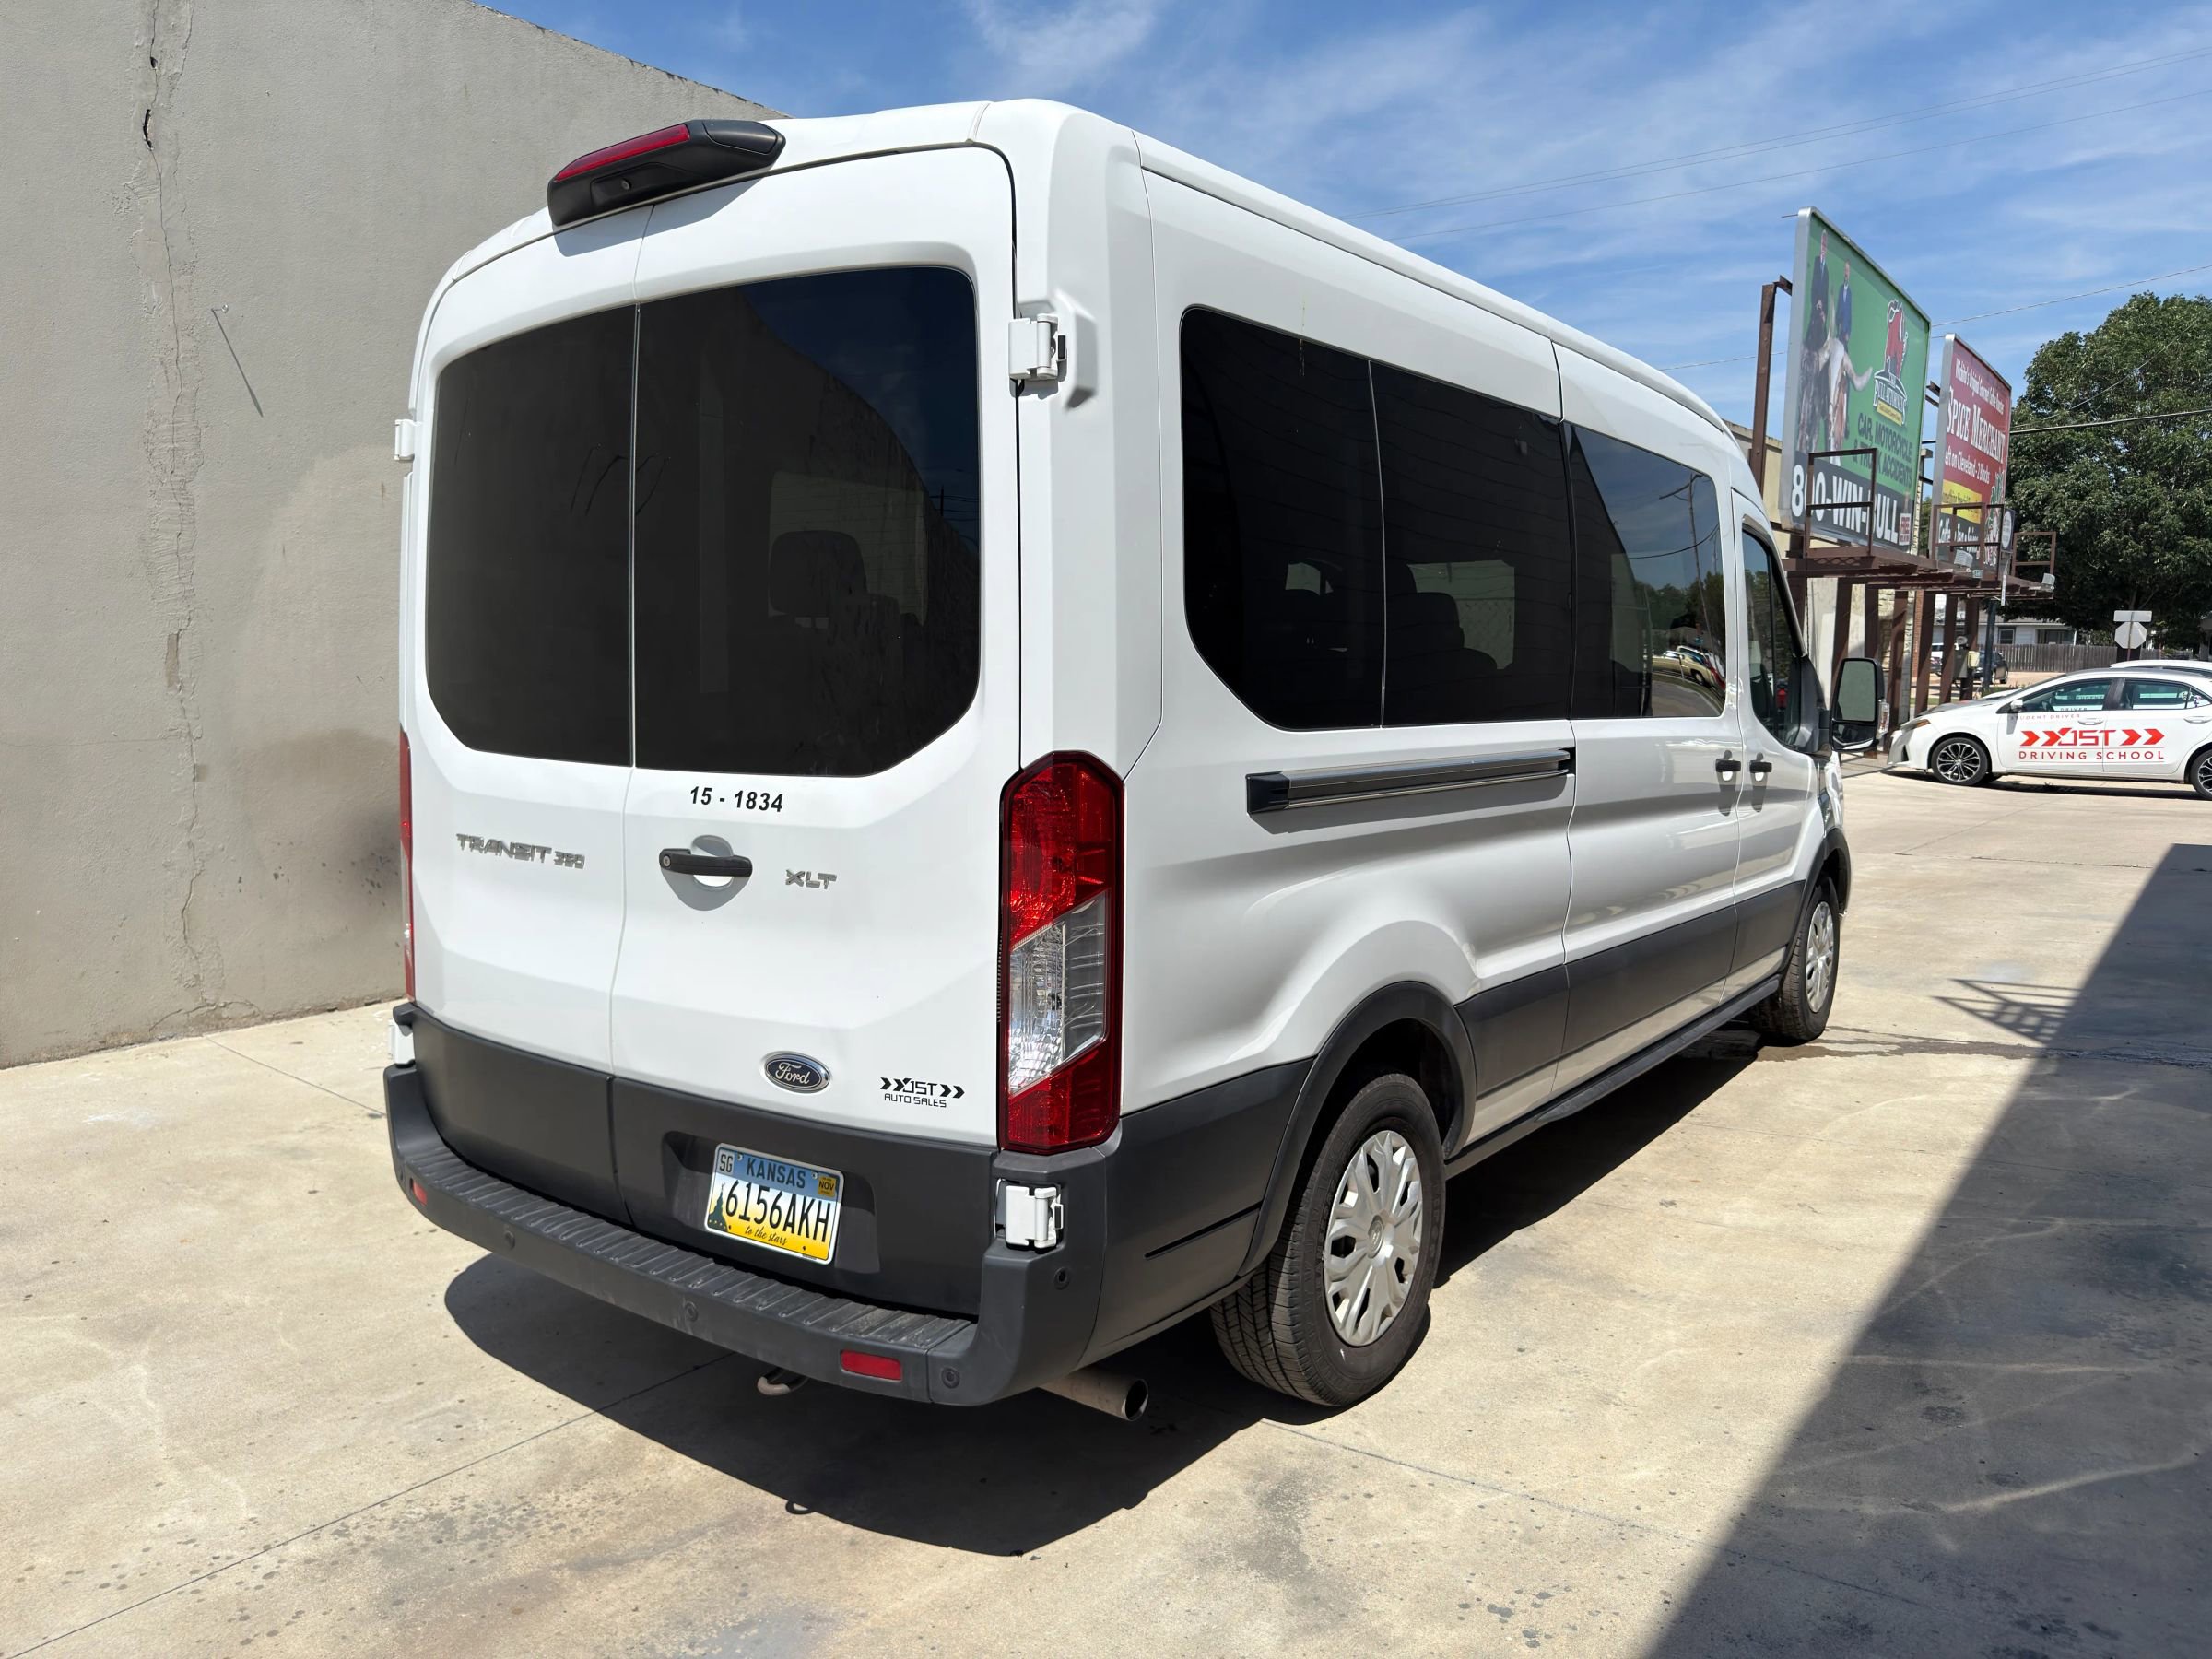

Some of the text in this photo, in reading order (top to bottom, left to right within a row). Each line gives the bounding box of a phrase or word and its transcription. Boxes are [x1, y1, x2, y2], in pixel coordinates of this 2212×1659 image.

[1947, 385, 2006, 464] SPICE MERCHANT
[1860, 442, 1882, 474] TRUK
[2018, 750, 2164, 760] DRIVING SCHOOL
[690, 786, 712, 806] 15
[734, 790, 783, 813] 1834
[455, 832, 552, 864] TRANSIT
[785, 869, 837, 890] XLT
[775, 1062, 810, 1085] Ford
[884, 1093, 947, 1108] AUTO SALES
[719, 1153, 734, 1173] SG
[746, 1157, 806, 1189] KANSAS
[818, 1180, 835, 1190] NOV
[725, 1179, 831, 1243] 6156AKH
[745, 1225, 787, 1246] to the stars
